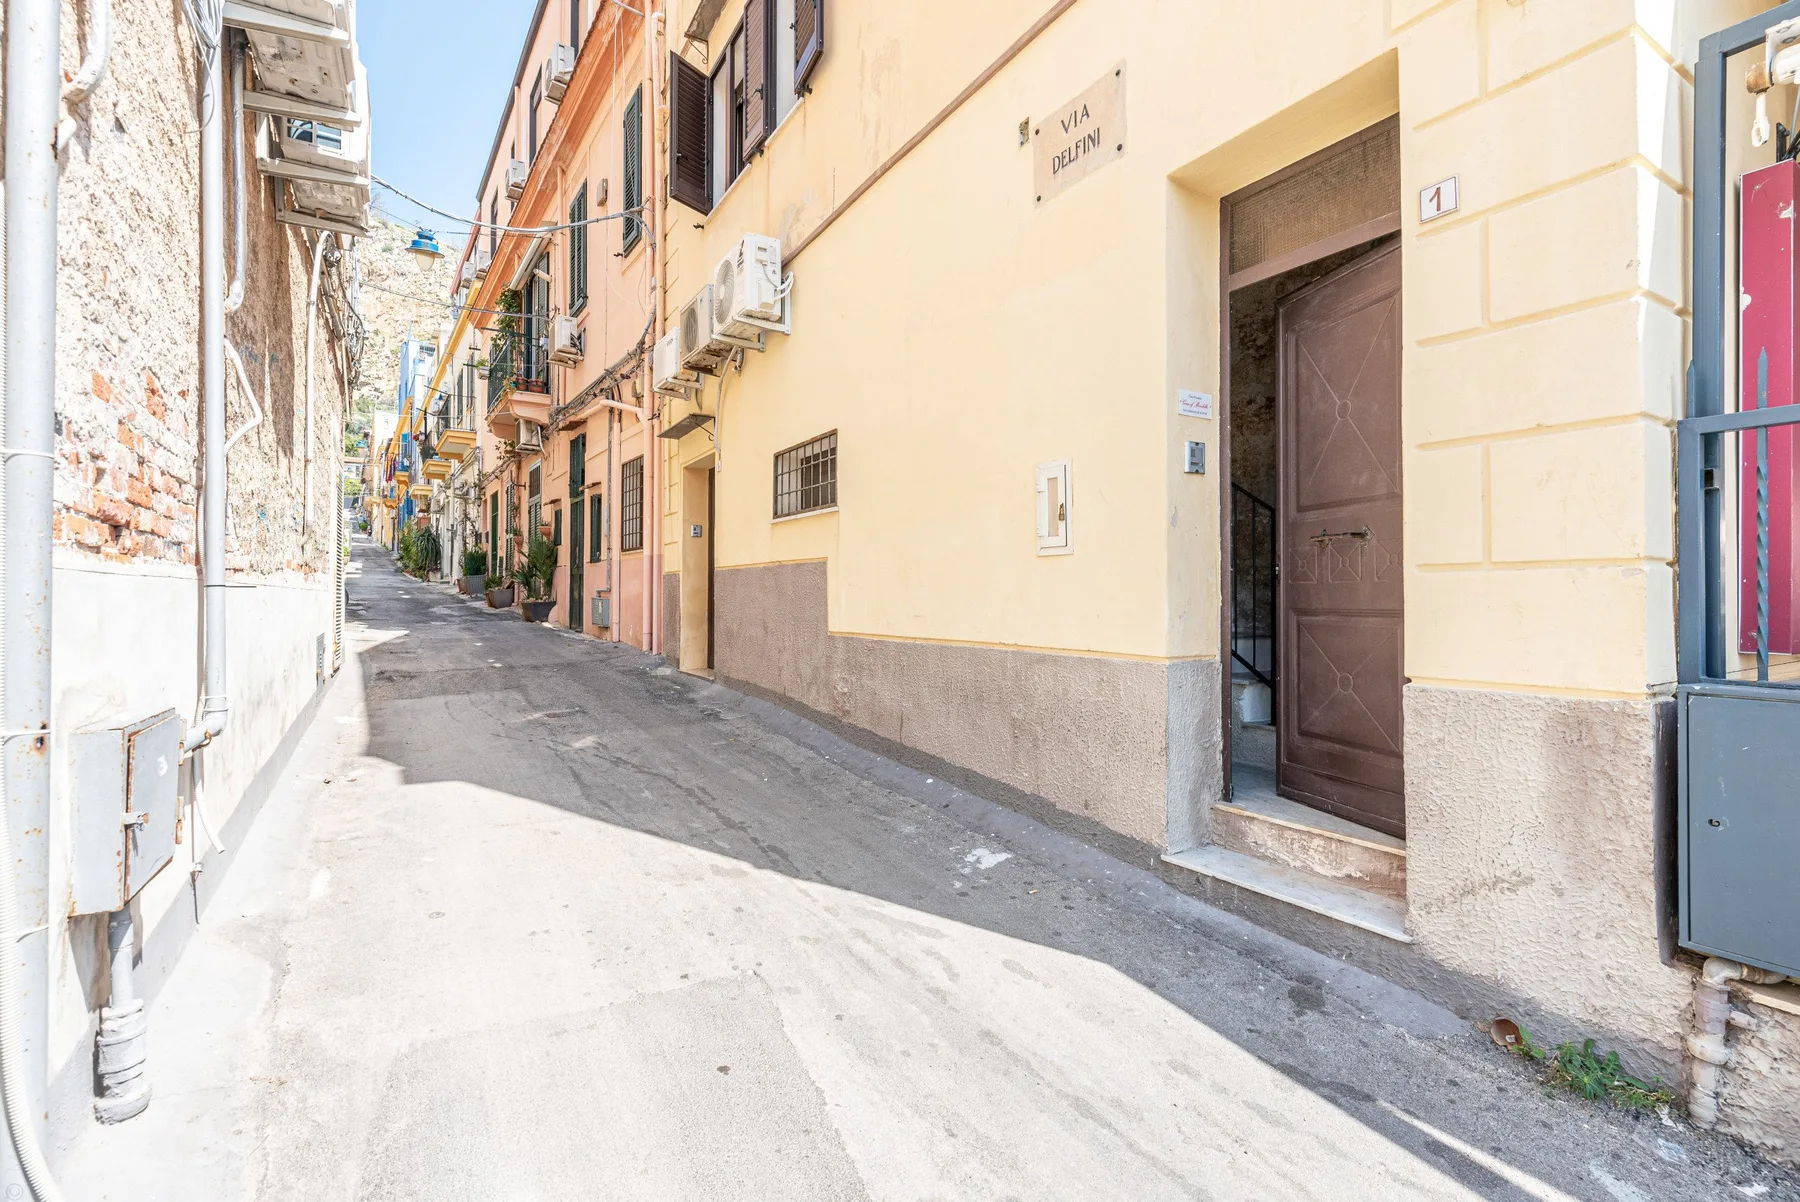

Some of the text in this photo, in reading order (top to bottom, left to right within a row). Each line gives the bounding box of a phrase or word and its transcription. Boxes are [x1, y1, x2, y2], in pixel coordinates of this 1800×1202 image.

[1061, 103, 1090, 134] VIA
[1052, 127, 1100, 175] DELFINI
[1429, 186, 1441, 212] 1
